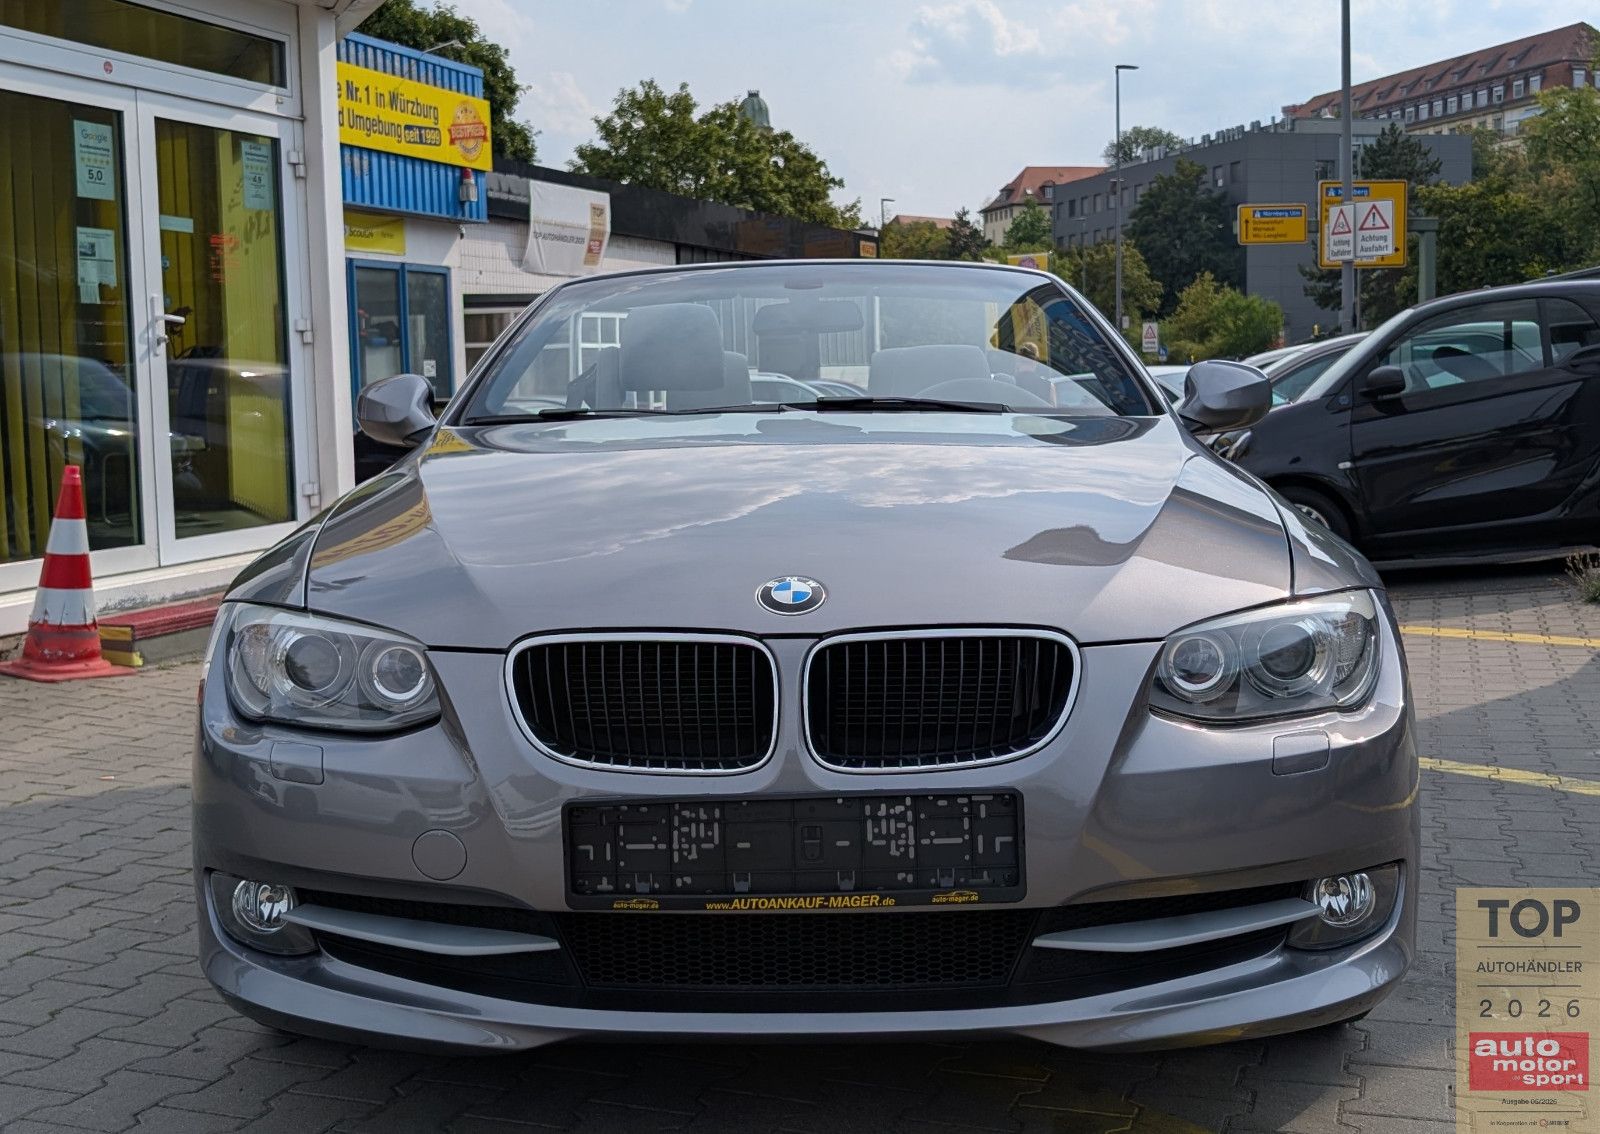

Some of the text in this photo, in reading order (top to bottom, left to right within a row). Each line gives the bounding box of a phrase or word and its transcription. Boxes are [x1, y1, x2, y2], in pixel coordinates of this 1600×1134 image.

[345, 79, 362, 103] Nr.
[364, 85, 370, 105] 1
[374, 86, 386, 109] in
[388, 89, 439, 125] Würzburg
[347, 108, 402, 143] Umgebung
[403, 128, 420, 141] seit
[421, 130, 440, 144] 1999
[81, 128, 108, 143] Google
[88, 169, 103, 181] 5,0
[1333, 239, 1350, 247] Achtung
[1361, 234, 1388, 243] Achtung
[1360, 244, 1388, 252] Ausfahrt
[706, 895, 896, 910] www.AUTOANKAUF-MAGER.de
[931, 895, 979, 903] auto-mager.de
